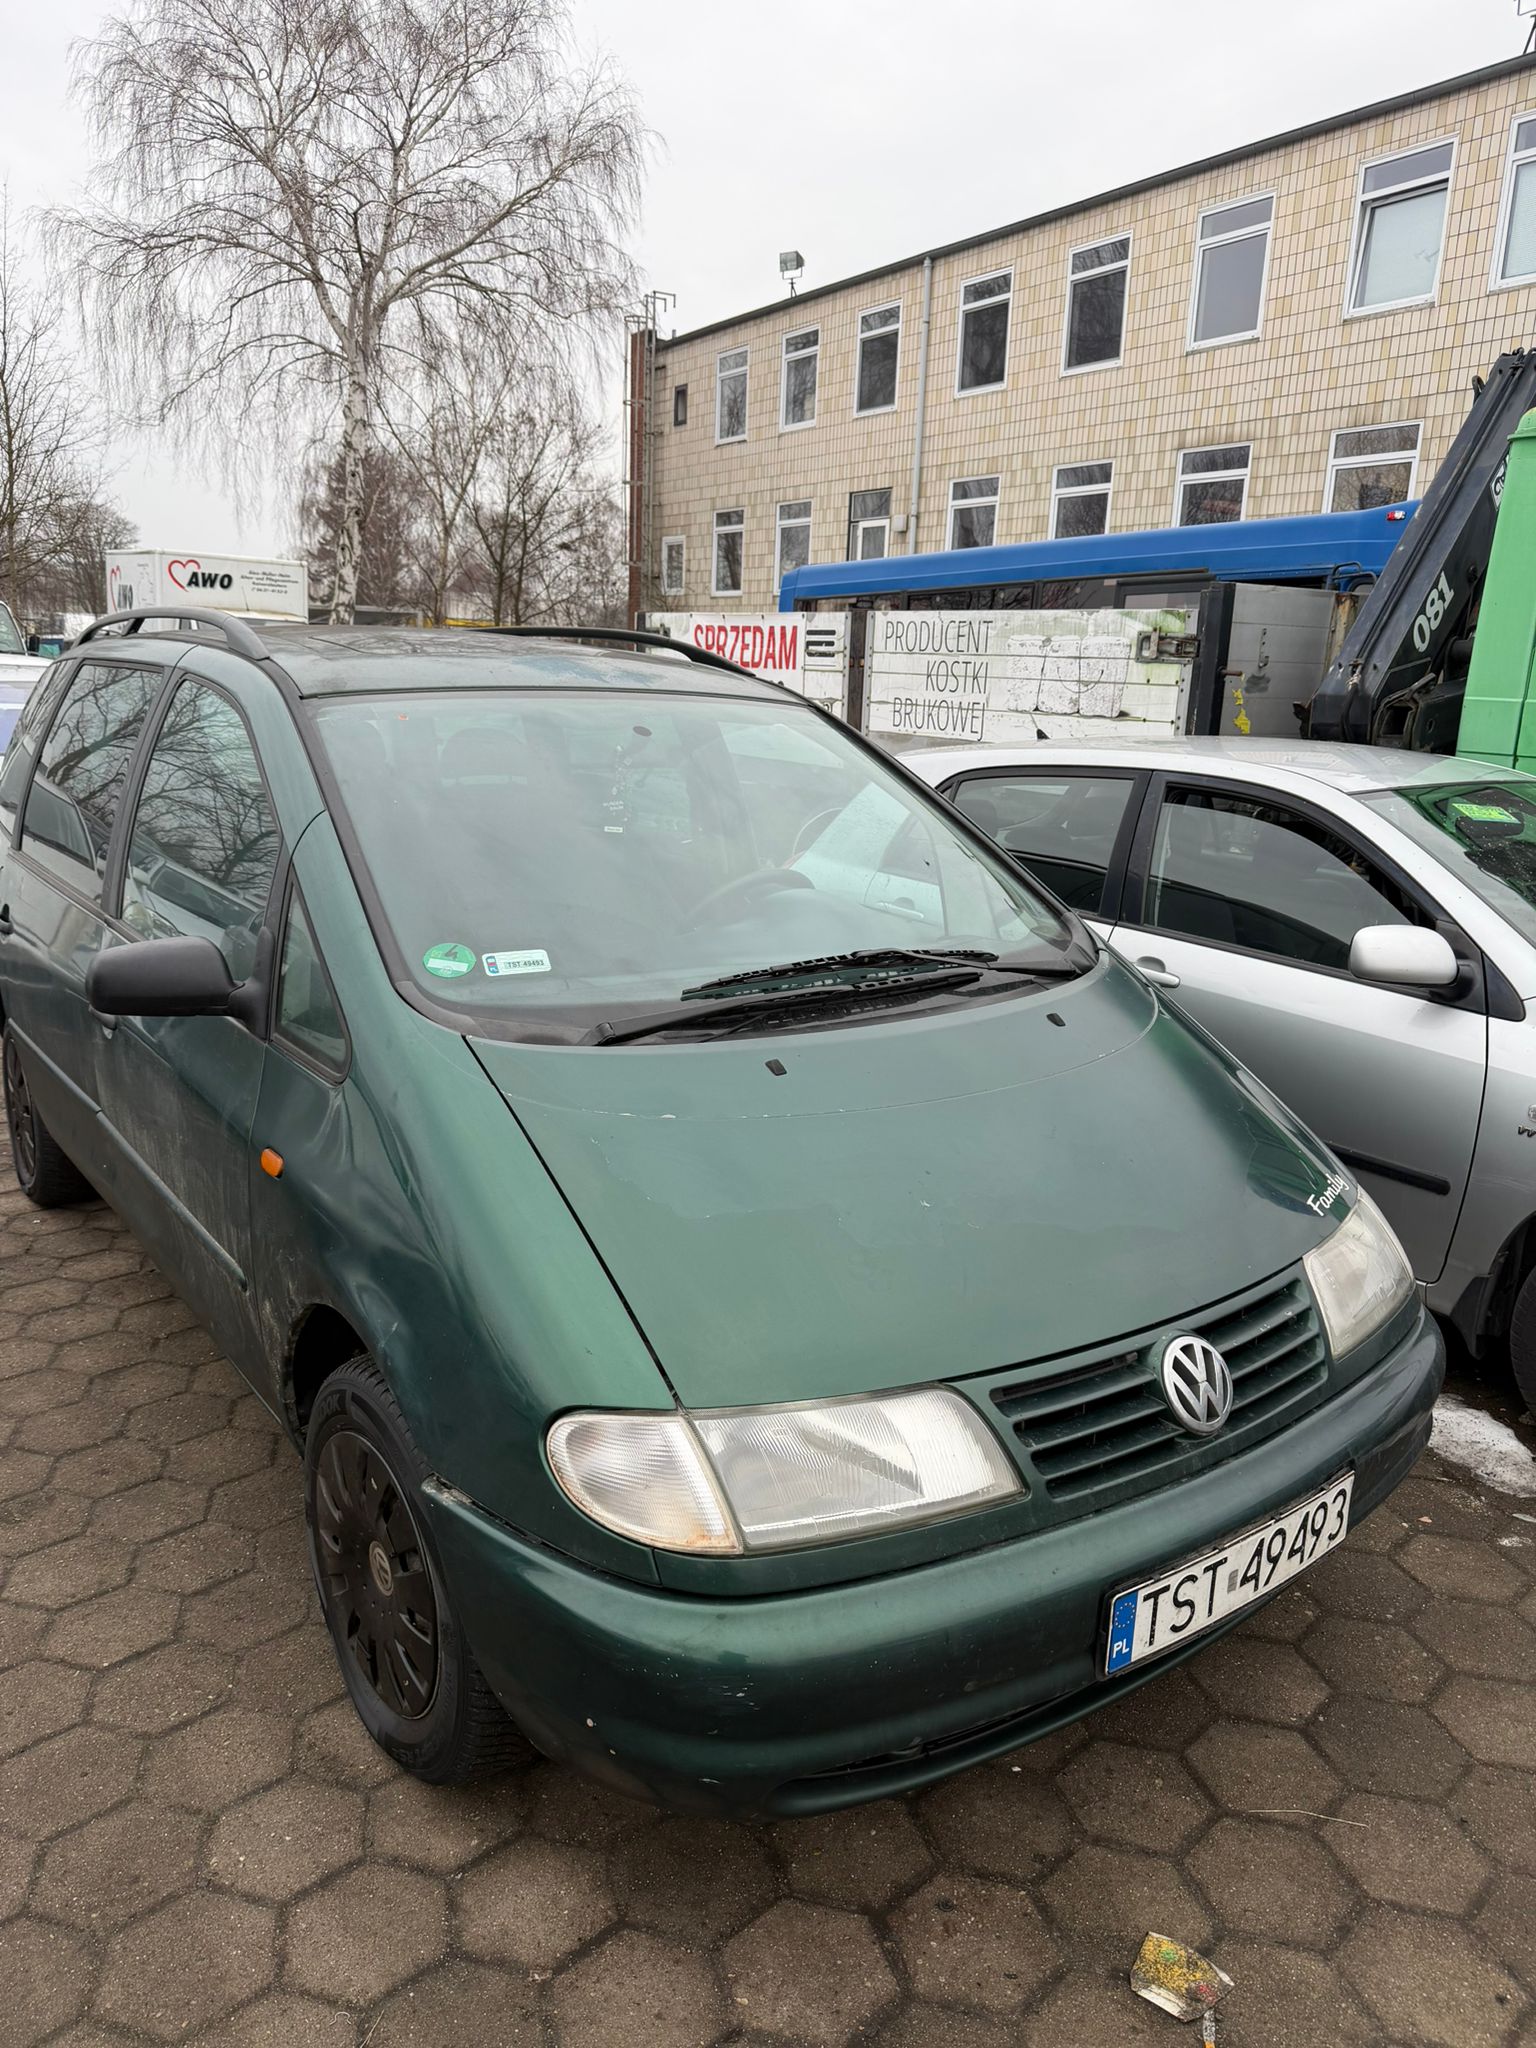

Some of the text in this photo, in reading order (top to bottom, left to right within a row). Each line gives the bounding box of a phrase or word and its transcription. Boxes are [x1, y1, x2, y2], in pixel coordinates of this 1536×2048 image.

[187, 571, 233, 590] AWO
[1412, 571, 1455, 653] 081
[884, 620, 994, 653] PRODUCENT
[925, 660, 989, 695] KOSTKI
[892, 697, 986, 742] BRUKOWEJ
[1306, 1173, 1350, 1217] Family
[1143, 1487, 1348, 1647] TST 49493
[1112, 1638, 1130, 1659] PL
